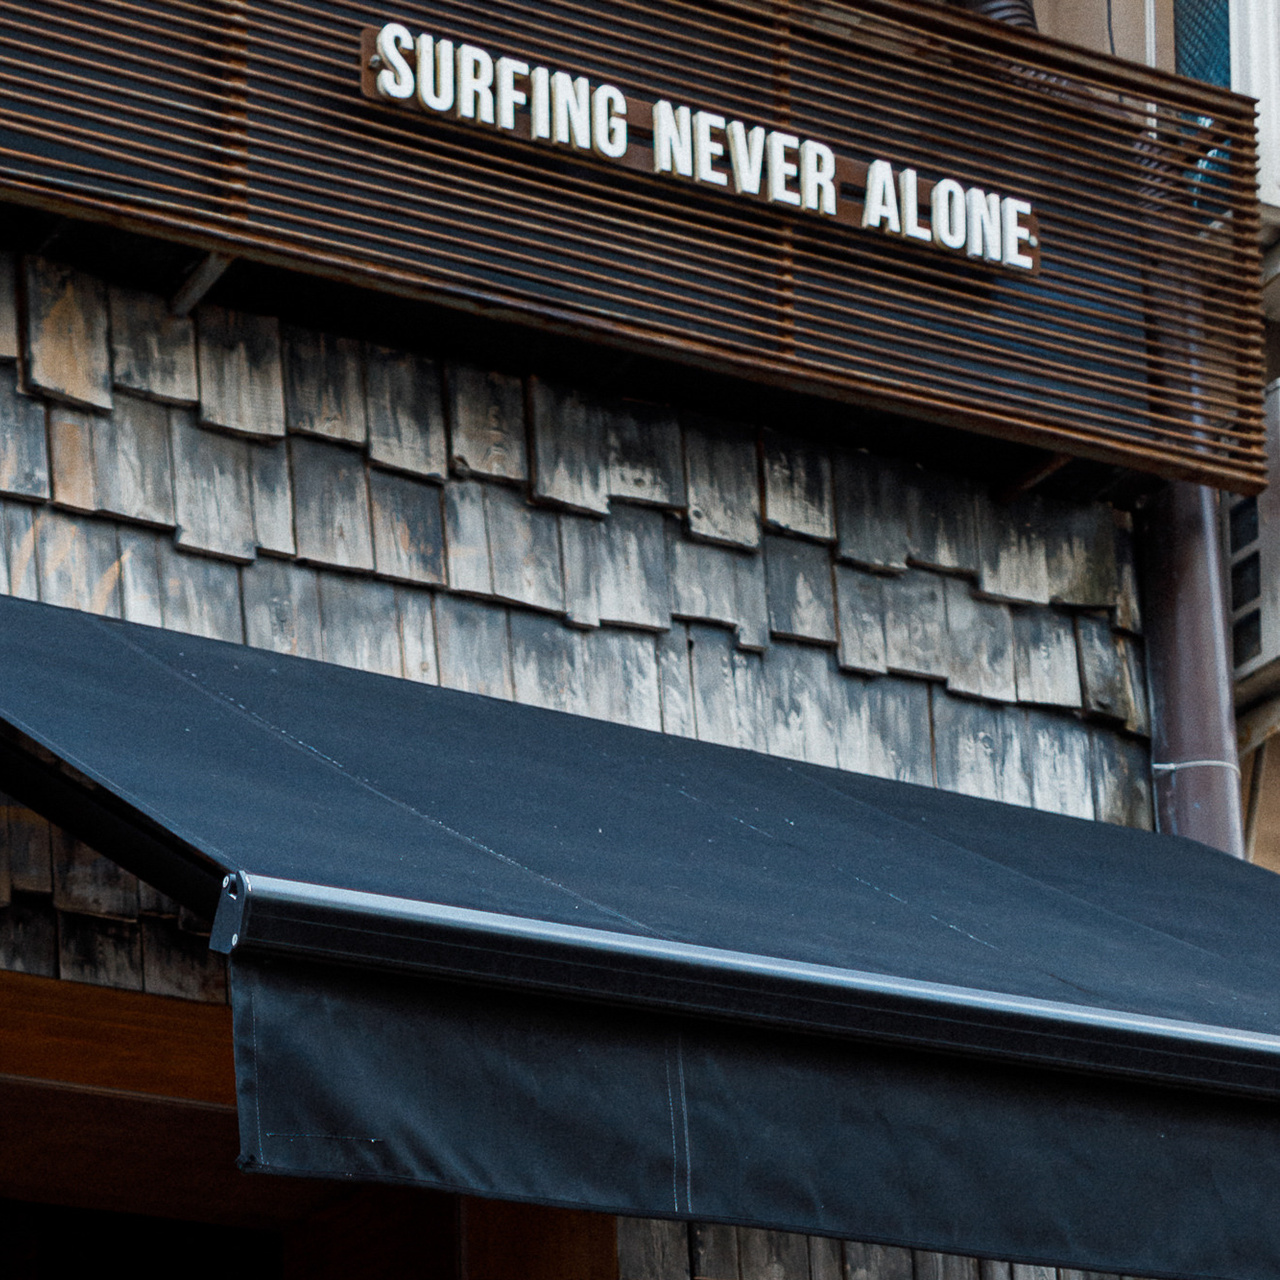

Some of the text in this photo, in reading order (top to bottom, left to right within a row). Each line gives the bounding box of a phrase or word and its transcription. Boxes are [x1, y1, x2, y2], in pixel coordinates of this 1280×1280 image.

[375, 22, 1034, 270] SURFING NEVER ALONE
